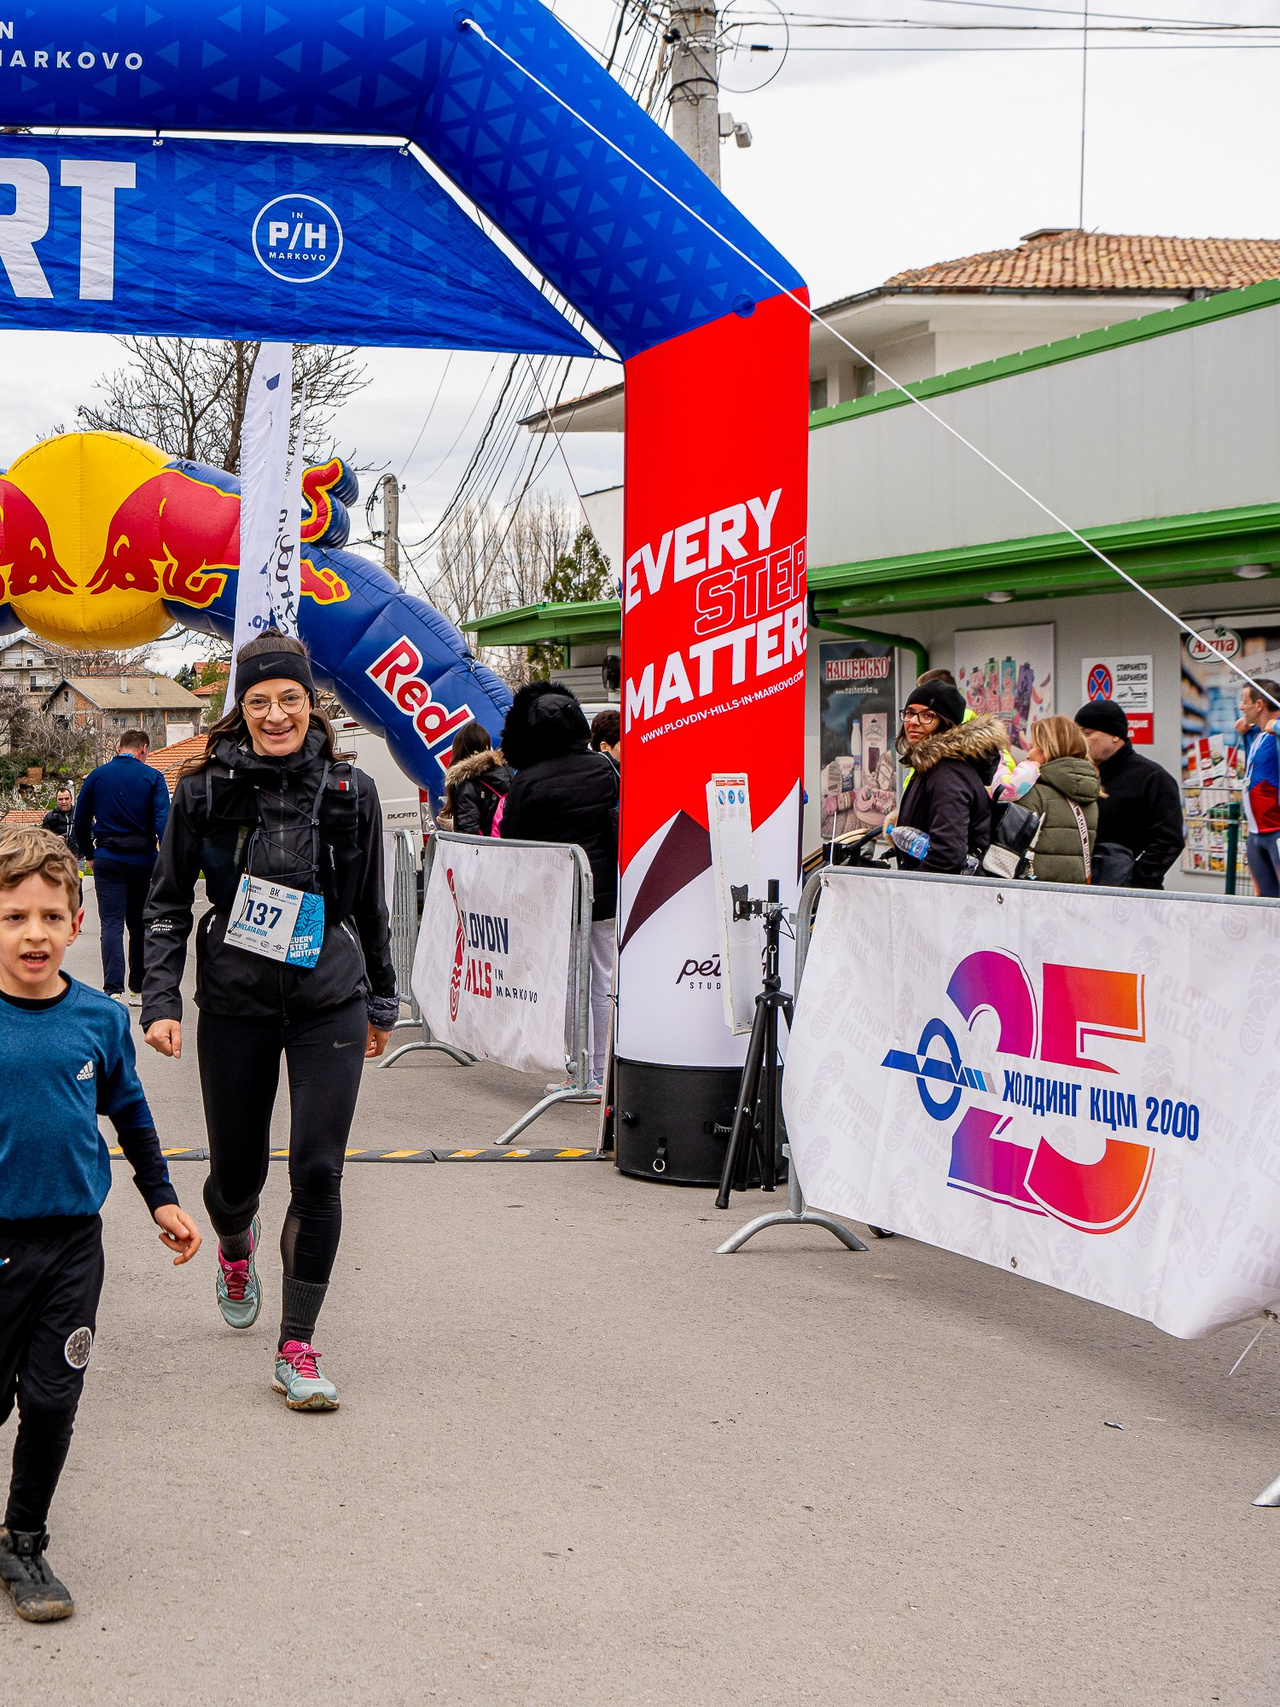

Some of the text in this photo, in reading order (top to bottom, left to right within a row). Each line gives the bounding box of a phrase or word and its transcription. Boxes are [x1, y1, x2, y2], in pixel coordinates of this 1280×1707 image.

[291, 211, 304, 219] IN
[269, 221, 326, 250] P/H
[269, 251, 326, 261] MARKOVO
[625, 488, 782, 615] EVERY
[694, 535, 807, 636] STEP
[367, 637, 473, 747] Red
[640, 669, 804, 745] WWW.PLOVDIV-HILLS-IN-MARKOVO.COM
[270, 887, 280, 897] 8K
[245, 899, 282, 929] 137
[495, 968, 504, 981] IN
[689, 981, 721, 990] STUD
[496, 985, 538, 1004] MARKOVO
[1002, 1069, 1082, 1118] ХОЛДИНГ
[1090, 1086, 1138, 1132] КЦМ
[1146, 1096, 1200, 1142] 2000
